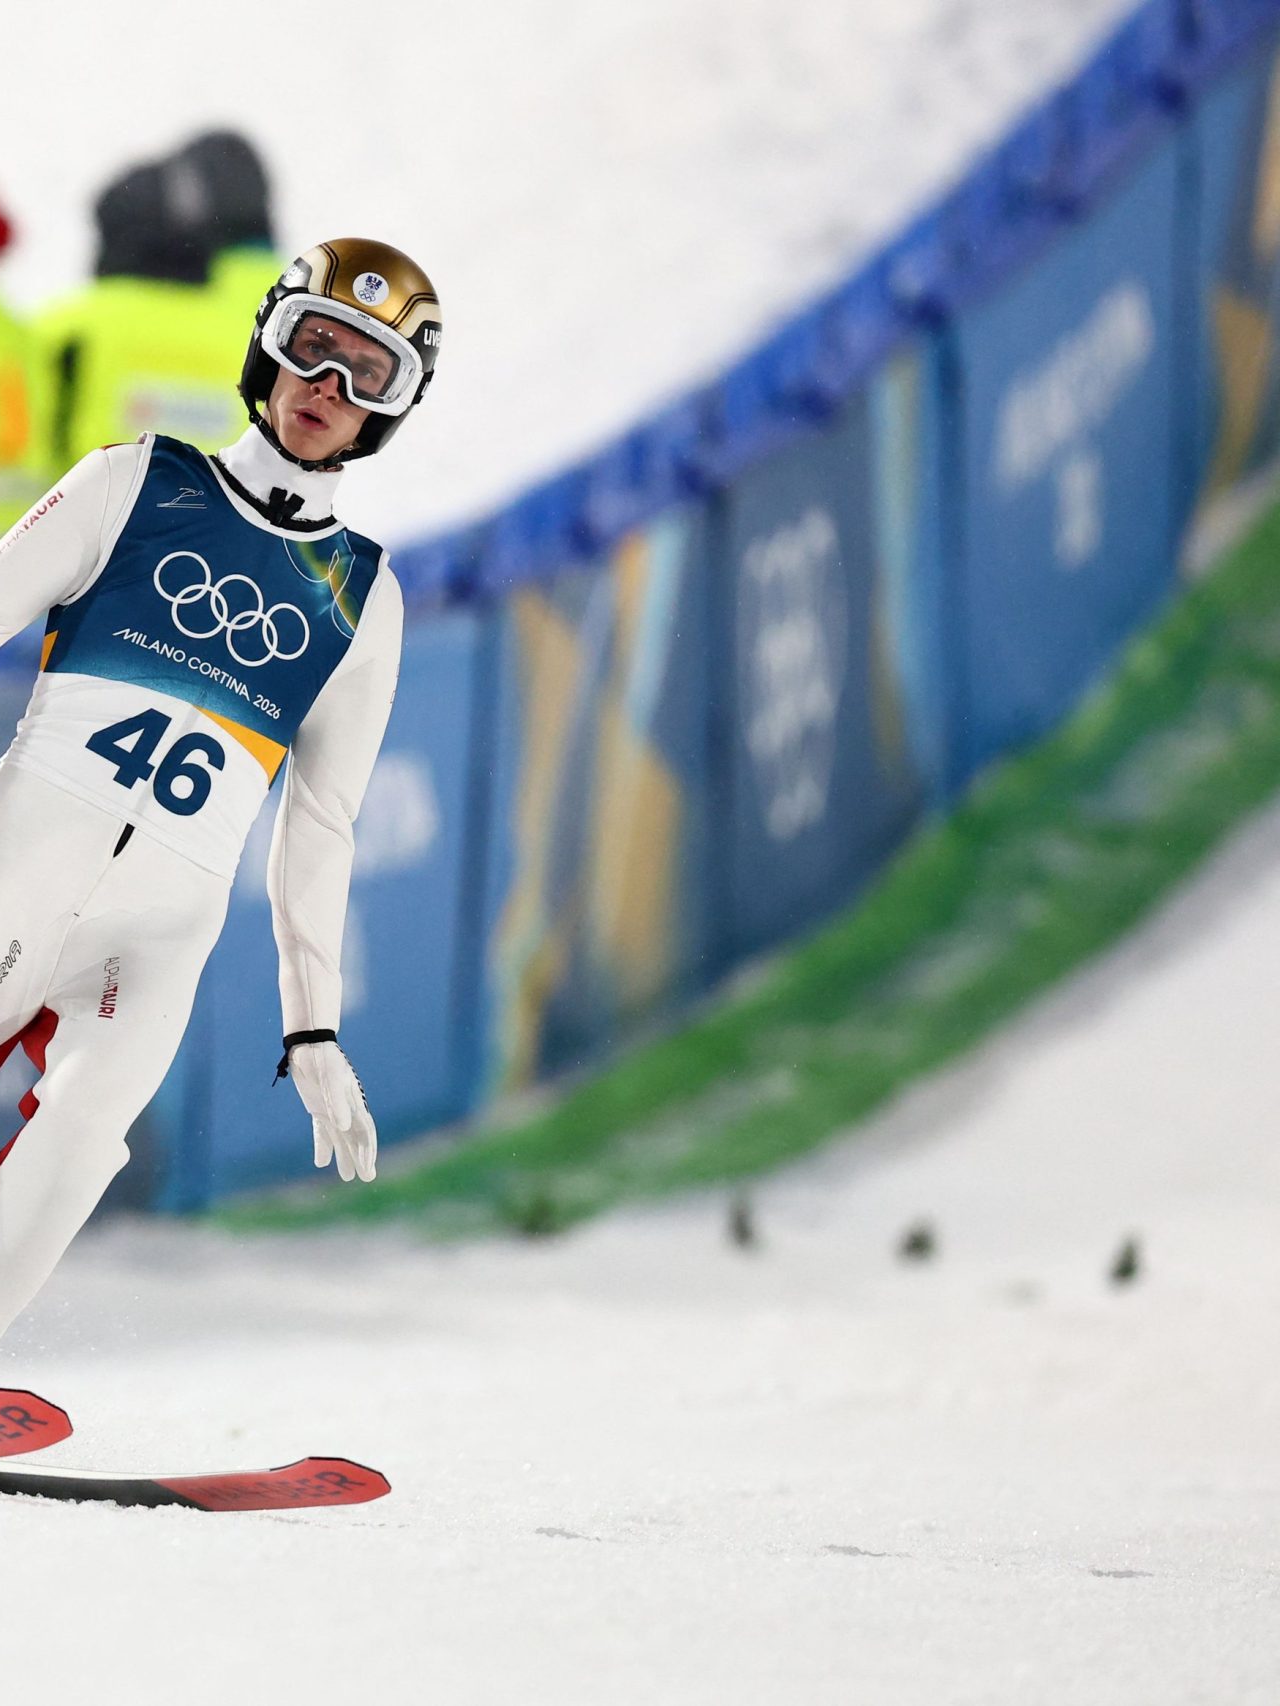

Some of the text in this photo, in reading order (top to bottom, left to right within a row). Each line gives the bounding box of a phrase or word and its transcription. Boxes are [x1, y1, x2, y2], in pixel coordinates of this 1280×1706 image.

[424, 328, 441, 347] uve
[111, 627, 283, 720] MILANO CORTINA 2026
[85, 708, 226, 817] 46
[97, 956, 120, 1019] ALPHATAURI
